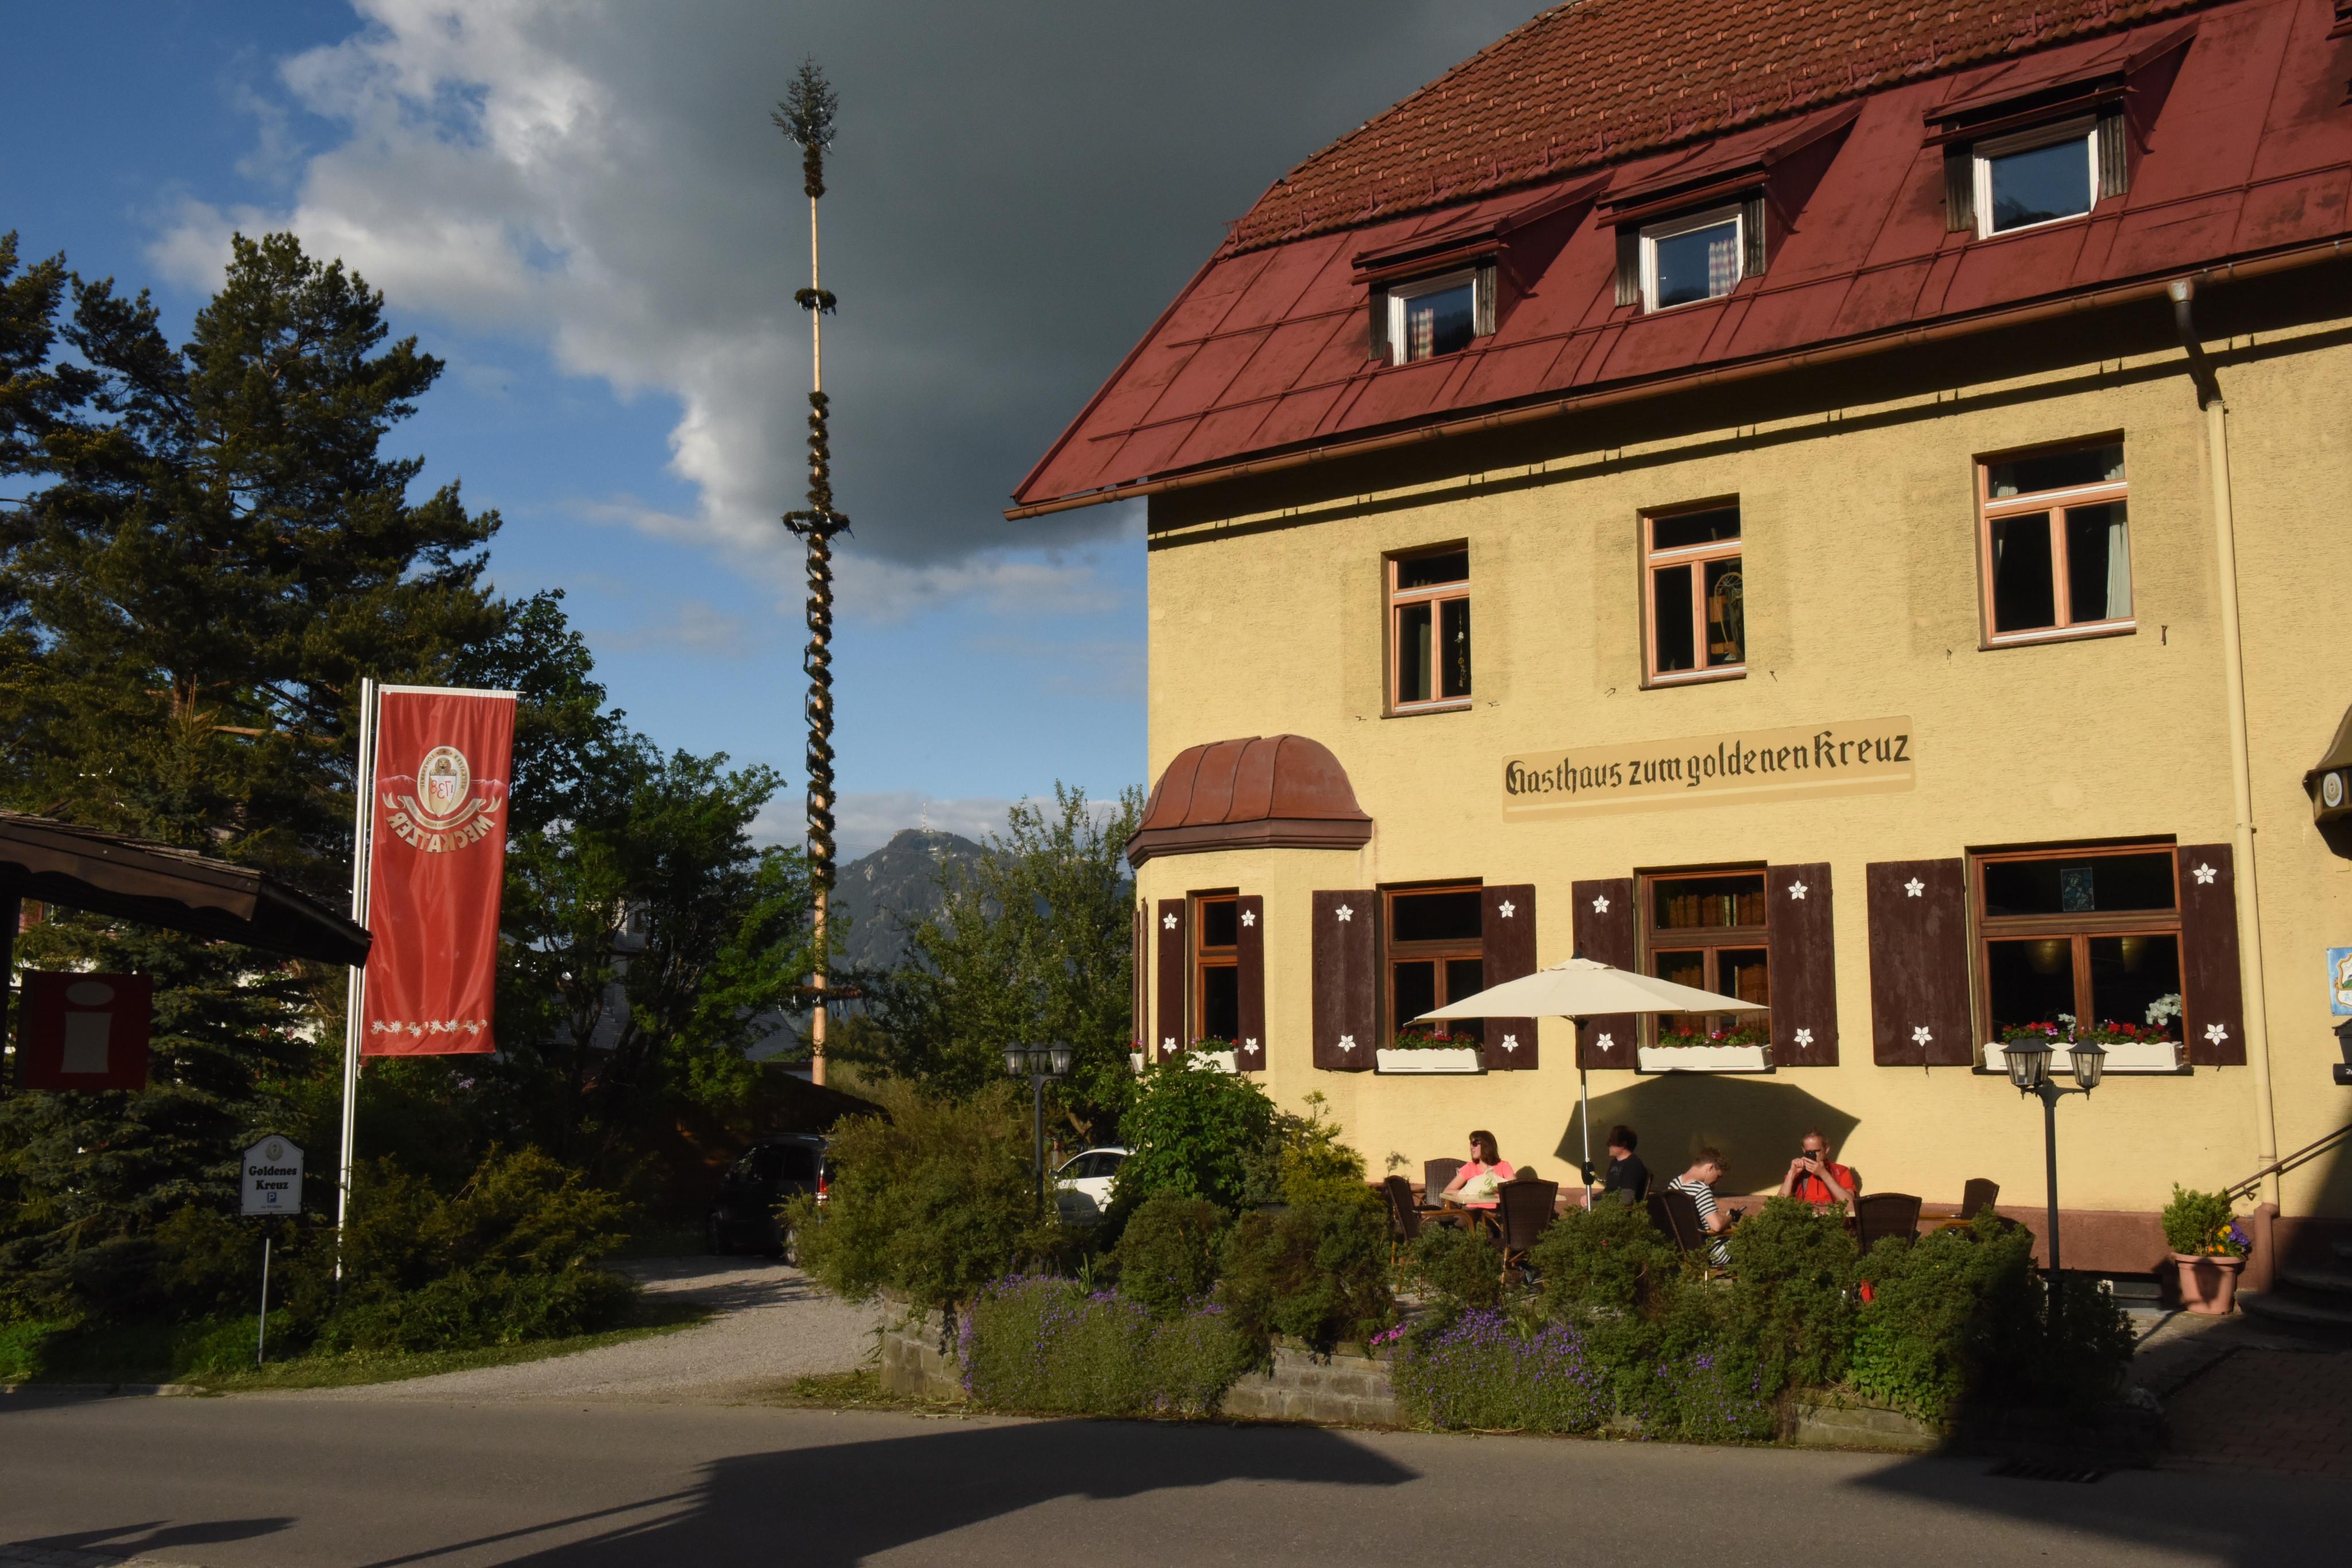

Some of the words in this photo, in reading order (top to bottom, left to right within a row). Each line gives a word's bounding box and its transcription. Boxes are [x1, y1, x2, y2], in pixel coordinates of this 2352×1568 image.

[1505, 758, 1622, 796] Gasthaus
[1628, 758, 1682, 785] zum
[1686, 740, 1810, 788] goldenen
[1813, 730, 1912, 769] Kreuz
[249, 1166, 297, 1176] Goldenes
[256, 1180, 289, 1190] Kreuz
